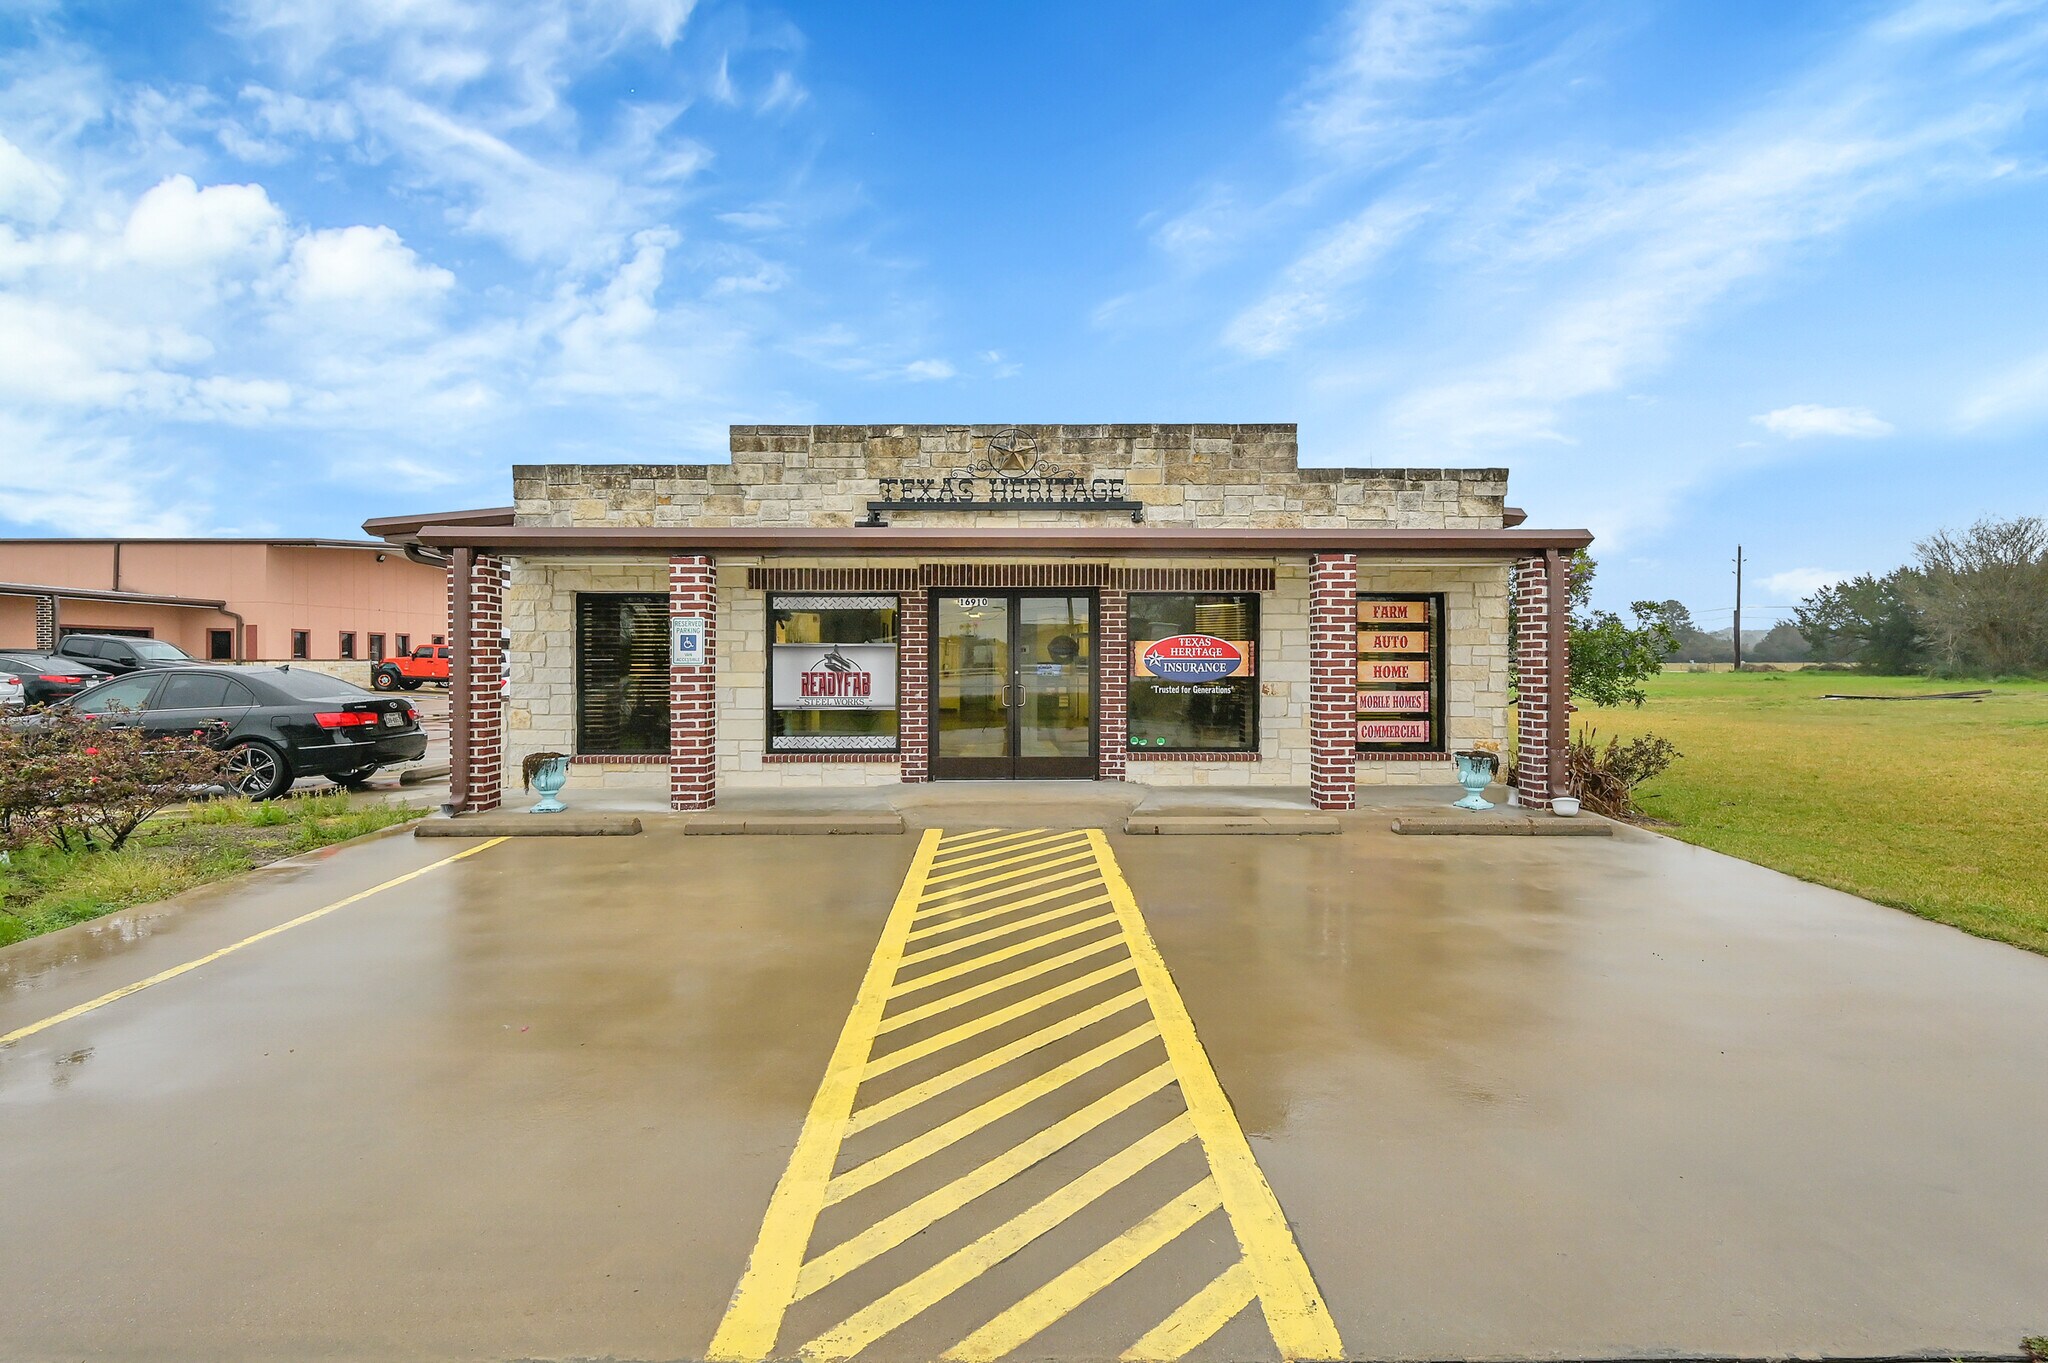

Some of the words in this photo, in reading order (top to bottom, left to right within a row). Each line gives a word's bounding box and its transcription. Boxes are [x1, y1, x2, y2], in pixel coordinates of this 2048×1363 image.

[879, 478, 975, 502] TEXAS
[989, 478, 1124, 502] HERITAGE
[960, 598, 988, 606] 16910
[1372, 605, 1408, 618] FARM
[1178, 637, 1211, 647] TEXAS
[1373, 635, 1408, 648] AUTO
[1170, 647, 1223, 657] HERITAGE
[1163, 662, 1227, 673] INSURANCE
[1373, 665, 1409, 679] HOME
[801, 672, 871, 696] READYFAB
[1181, 685, 1191, 694] for
[804, 698, 832, 706] STEEL
[833, 698, 865, 706] WORKS
[1359, 695, 1390, 709] MOBILE
[1392, 695, 1422, 709] HOMES
[1361, 725, 1422, 738] COMMERCIAL
